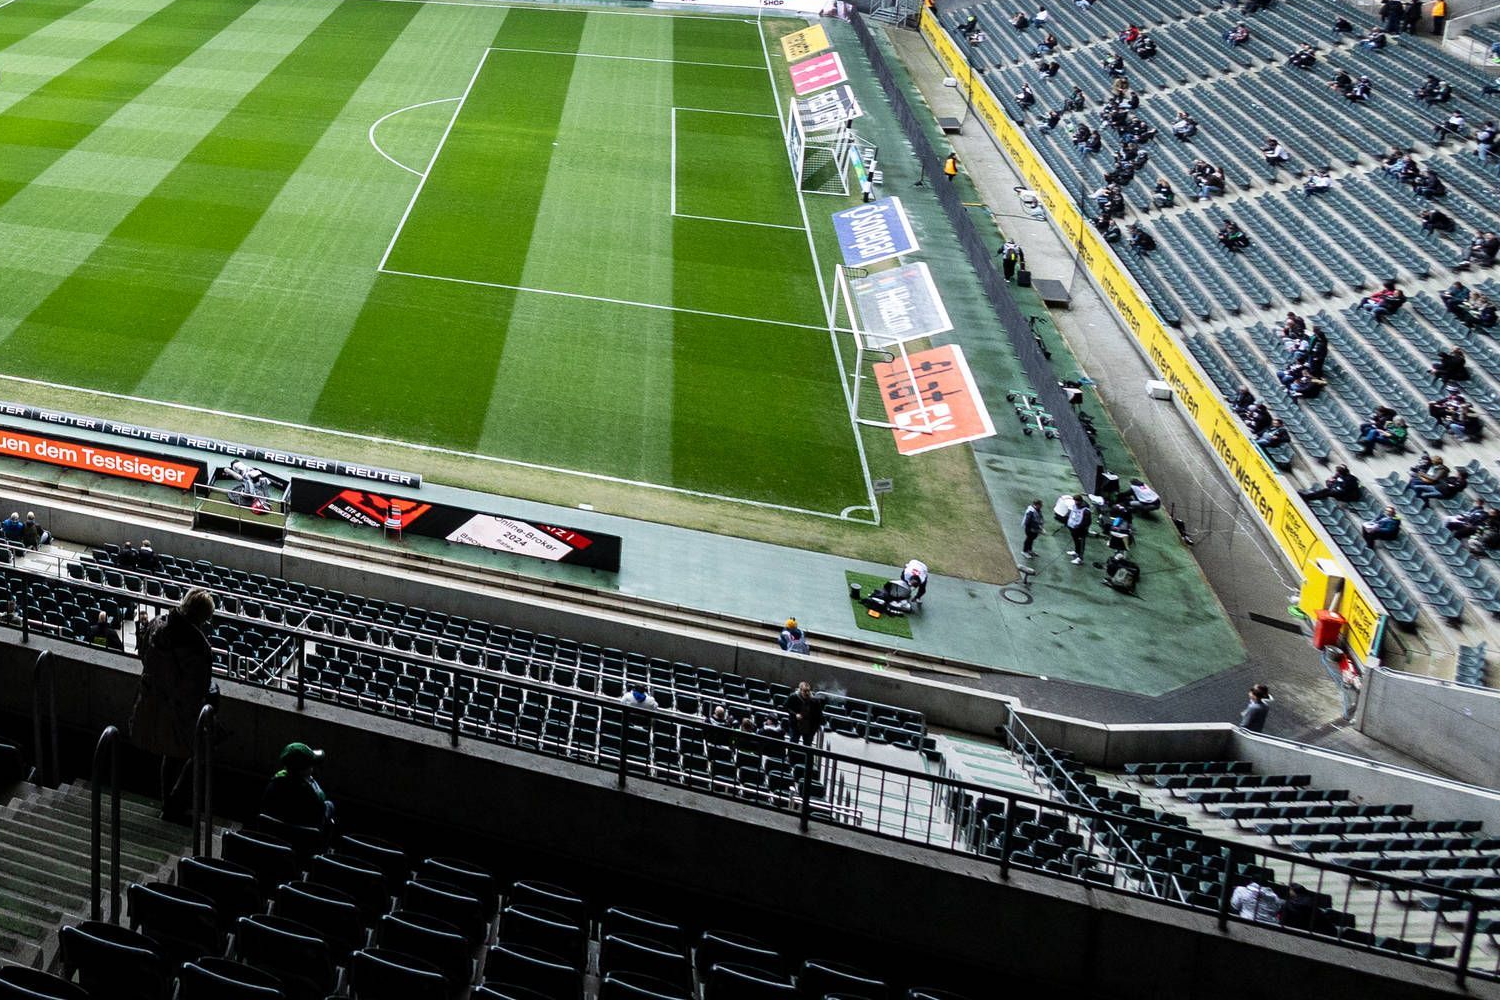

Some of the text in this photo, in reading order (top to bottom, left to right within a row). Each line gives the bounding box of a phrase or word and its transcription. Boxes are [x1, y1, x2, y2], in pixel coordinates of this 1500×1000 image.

[848, 213, 897, 259] sonepar
[1102, 275, 1142, 338] interwetten
[1151, 341, 1200, 420] interwetten
[39, 411, 95, 429] REUTER
[112, 423, 171, 443] REUTER
[187, 438, 247, 457] REUTER
[35, 435, 77, 463] dem
[82, 448, 185, 484] Testsieger
[265, 452, 327, 471] REUTER
[345, 466, 412, 485] REUTER
[1211, 427, 1274, 527] interwetten
[328, 503, 351, 519] BROKER
[494, 516, 558, 552] Online-Broker
[503, 531, 527, 547] 2024
